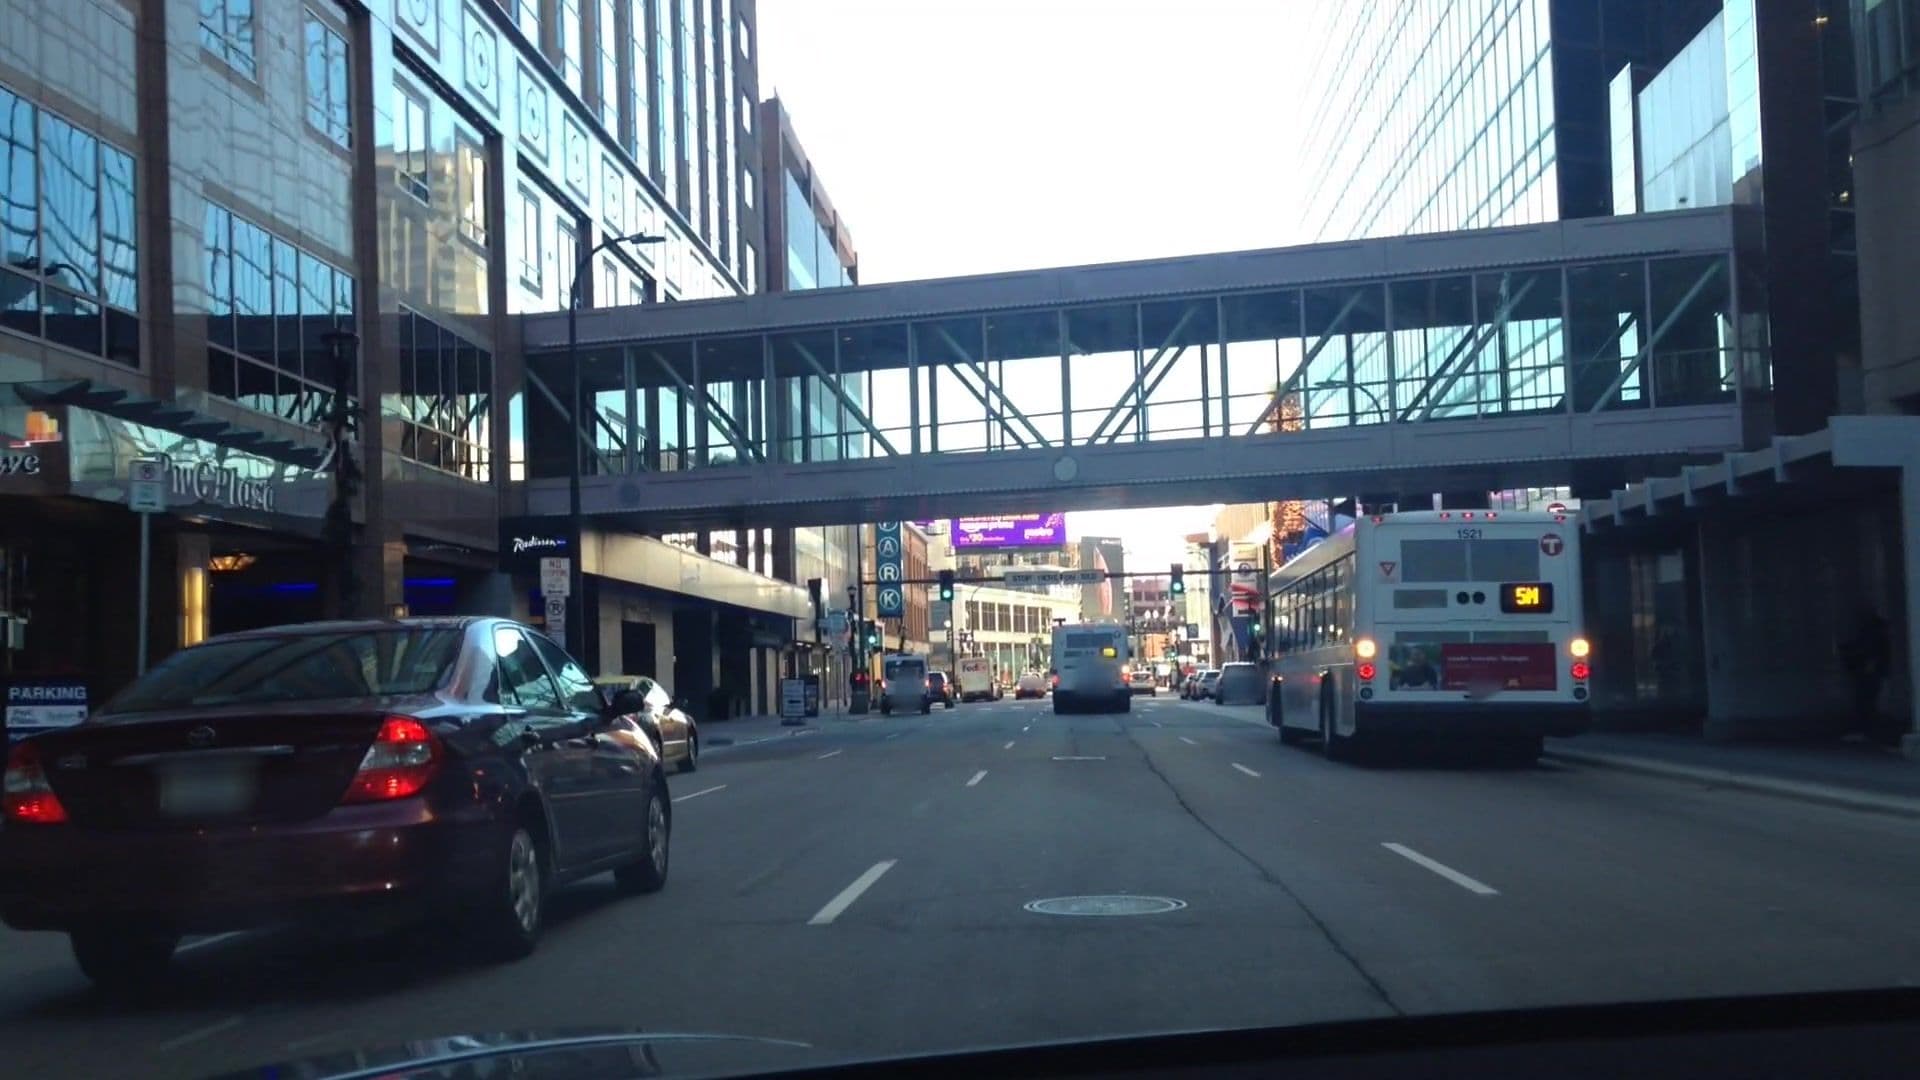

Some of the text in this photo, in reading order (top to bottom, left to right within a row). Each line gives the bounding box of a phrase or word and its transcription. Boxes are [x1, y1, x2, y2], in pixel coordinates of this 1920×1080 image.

[1457, 529, 1482, 539] 1521
[513, 536, 557, 552] Radisson
[8, 687, 87, 699] PARKING
